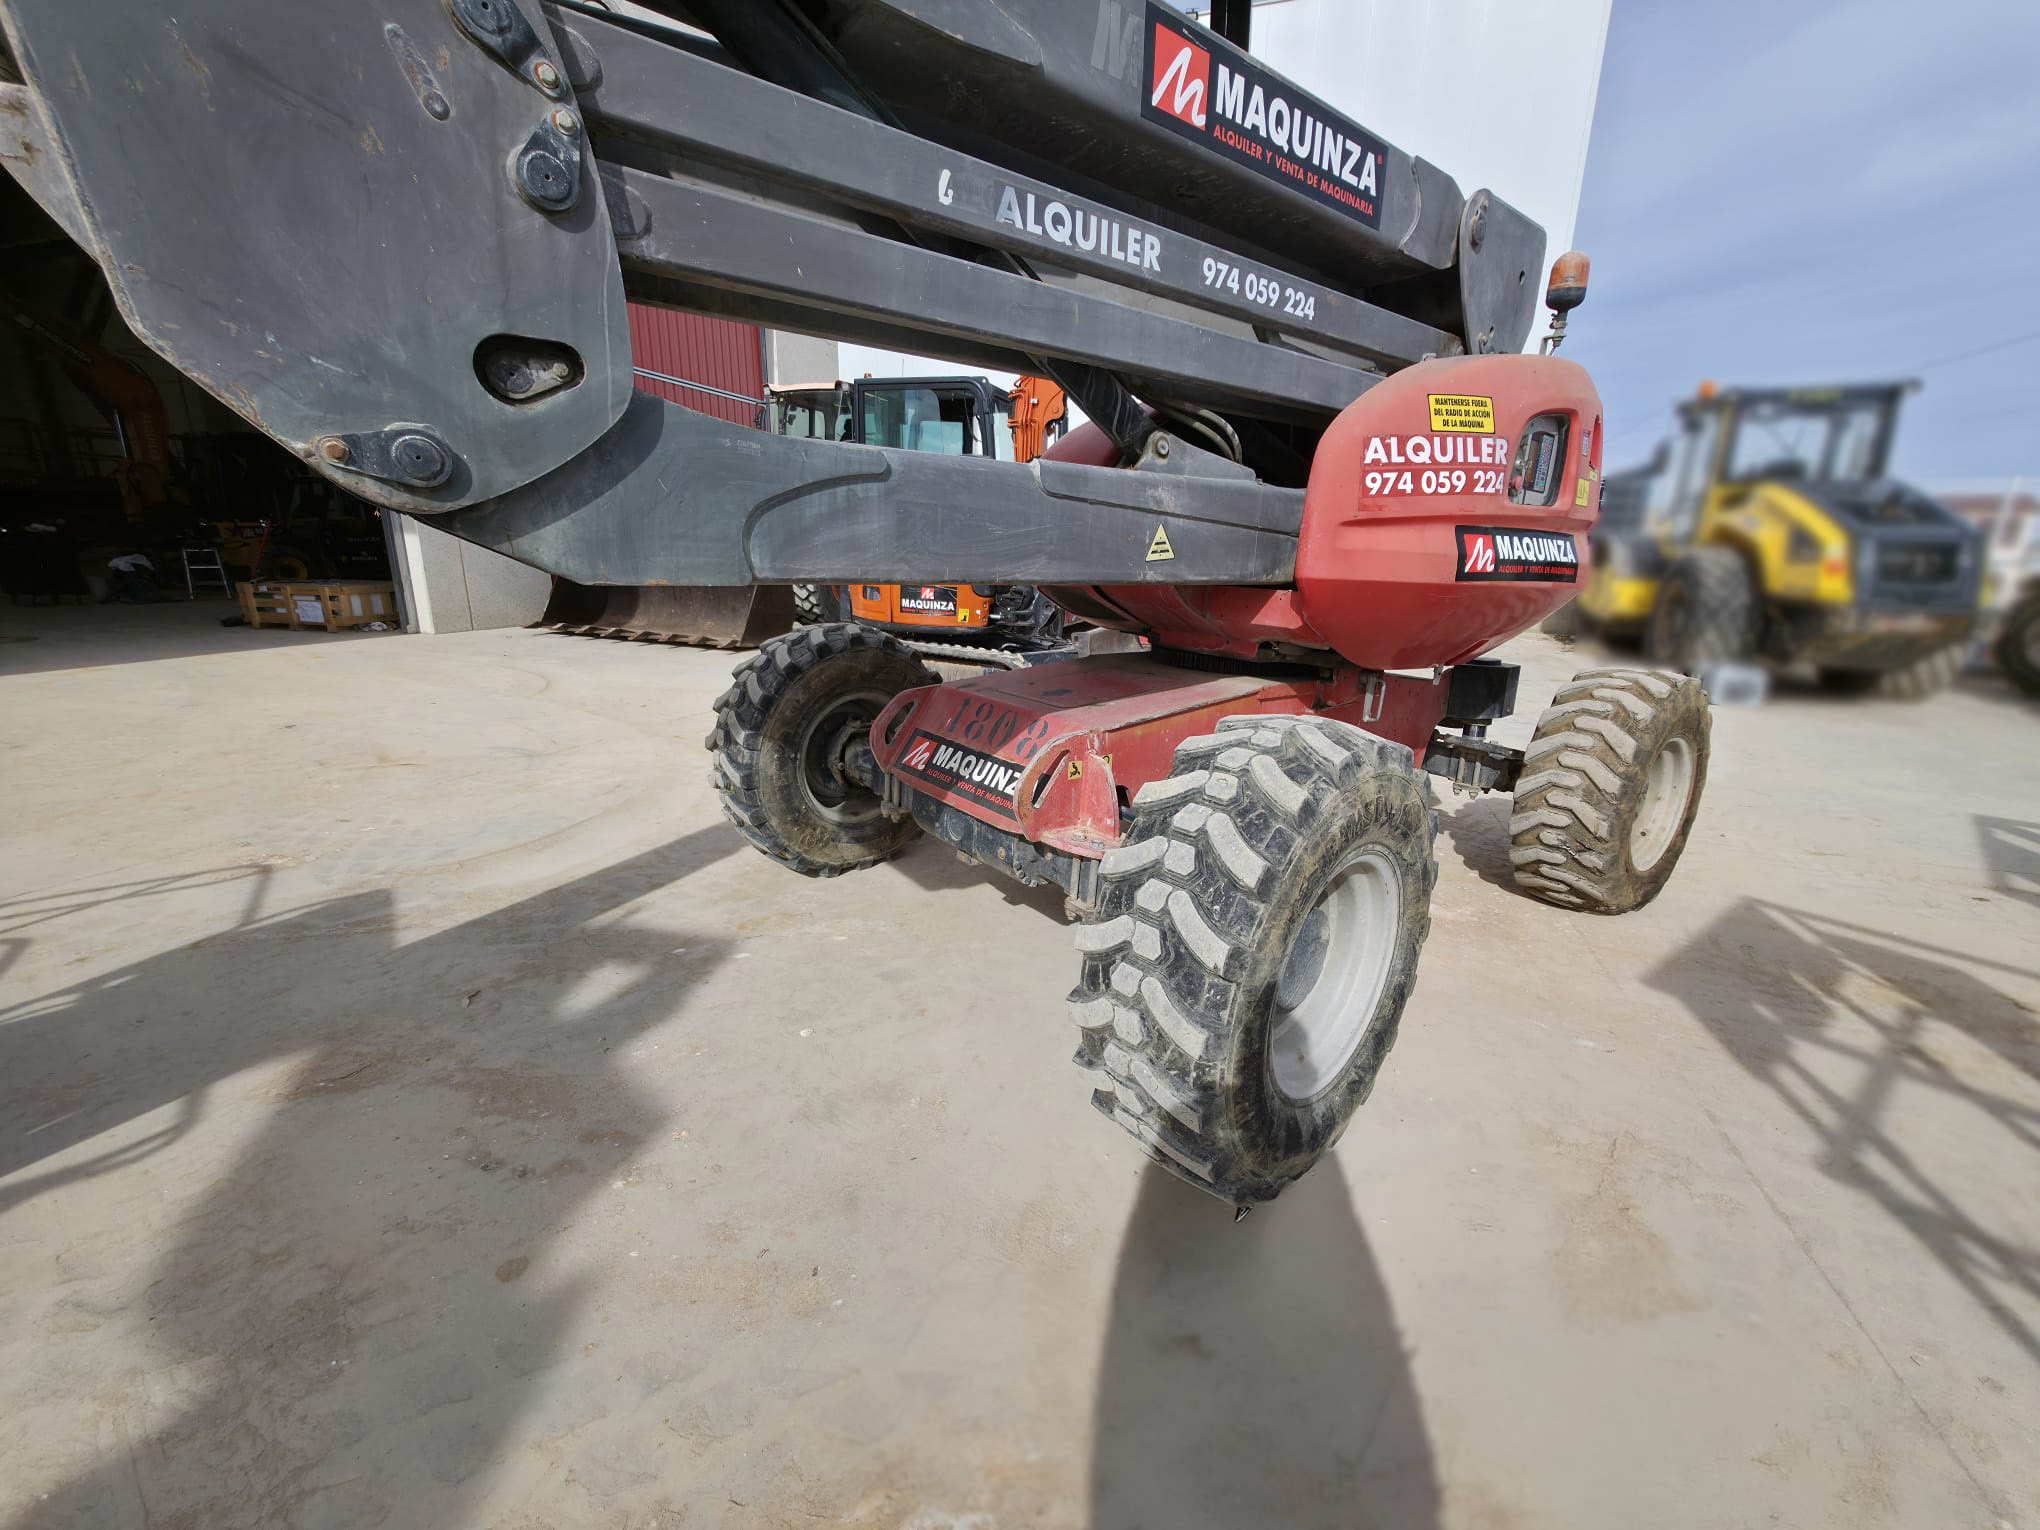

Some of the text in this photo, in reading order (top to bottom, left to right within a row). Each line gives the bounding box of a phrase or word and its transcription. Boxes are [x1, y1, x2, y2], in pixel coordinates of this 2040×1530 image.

[1215, 63, 1377, 197] MAQUINZA
[1213, 124, 1373, 216] ALQUILER Y VENTA DE MAQUINARIA
[995, 185, 1162, 272] ALQUILER
[1202, 257, 1316, 321] 974 059 224
[1434, 408, 1444, 416] DEL
[1445, 409, 1462, 417] RADIO
[1464, 409, 1470, 417] DE
[1435, 398, 1470, 406] MANTENERSE
[1443, 419, 1449, 427] DE
[1364, 436, 1508, 465] ALQUILER
[1365, 470, 1505, 496] 974 059 224
[1495, 535, 1576, 563] MAQUINZA
[901, 598, 955, 610] MAQUINZA
[947, 698, 1049, 759] 1808
[932, 744, 1038, 796] MAQUINZ
[957, 781, 976, 793] VENTA
[976, 788, 985, 797] DE
